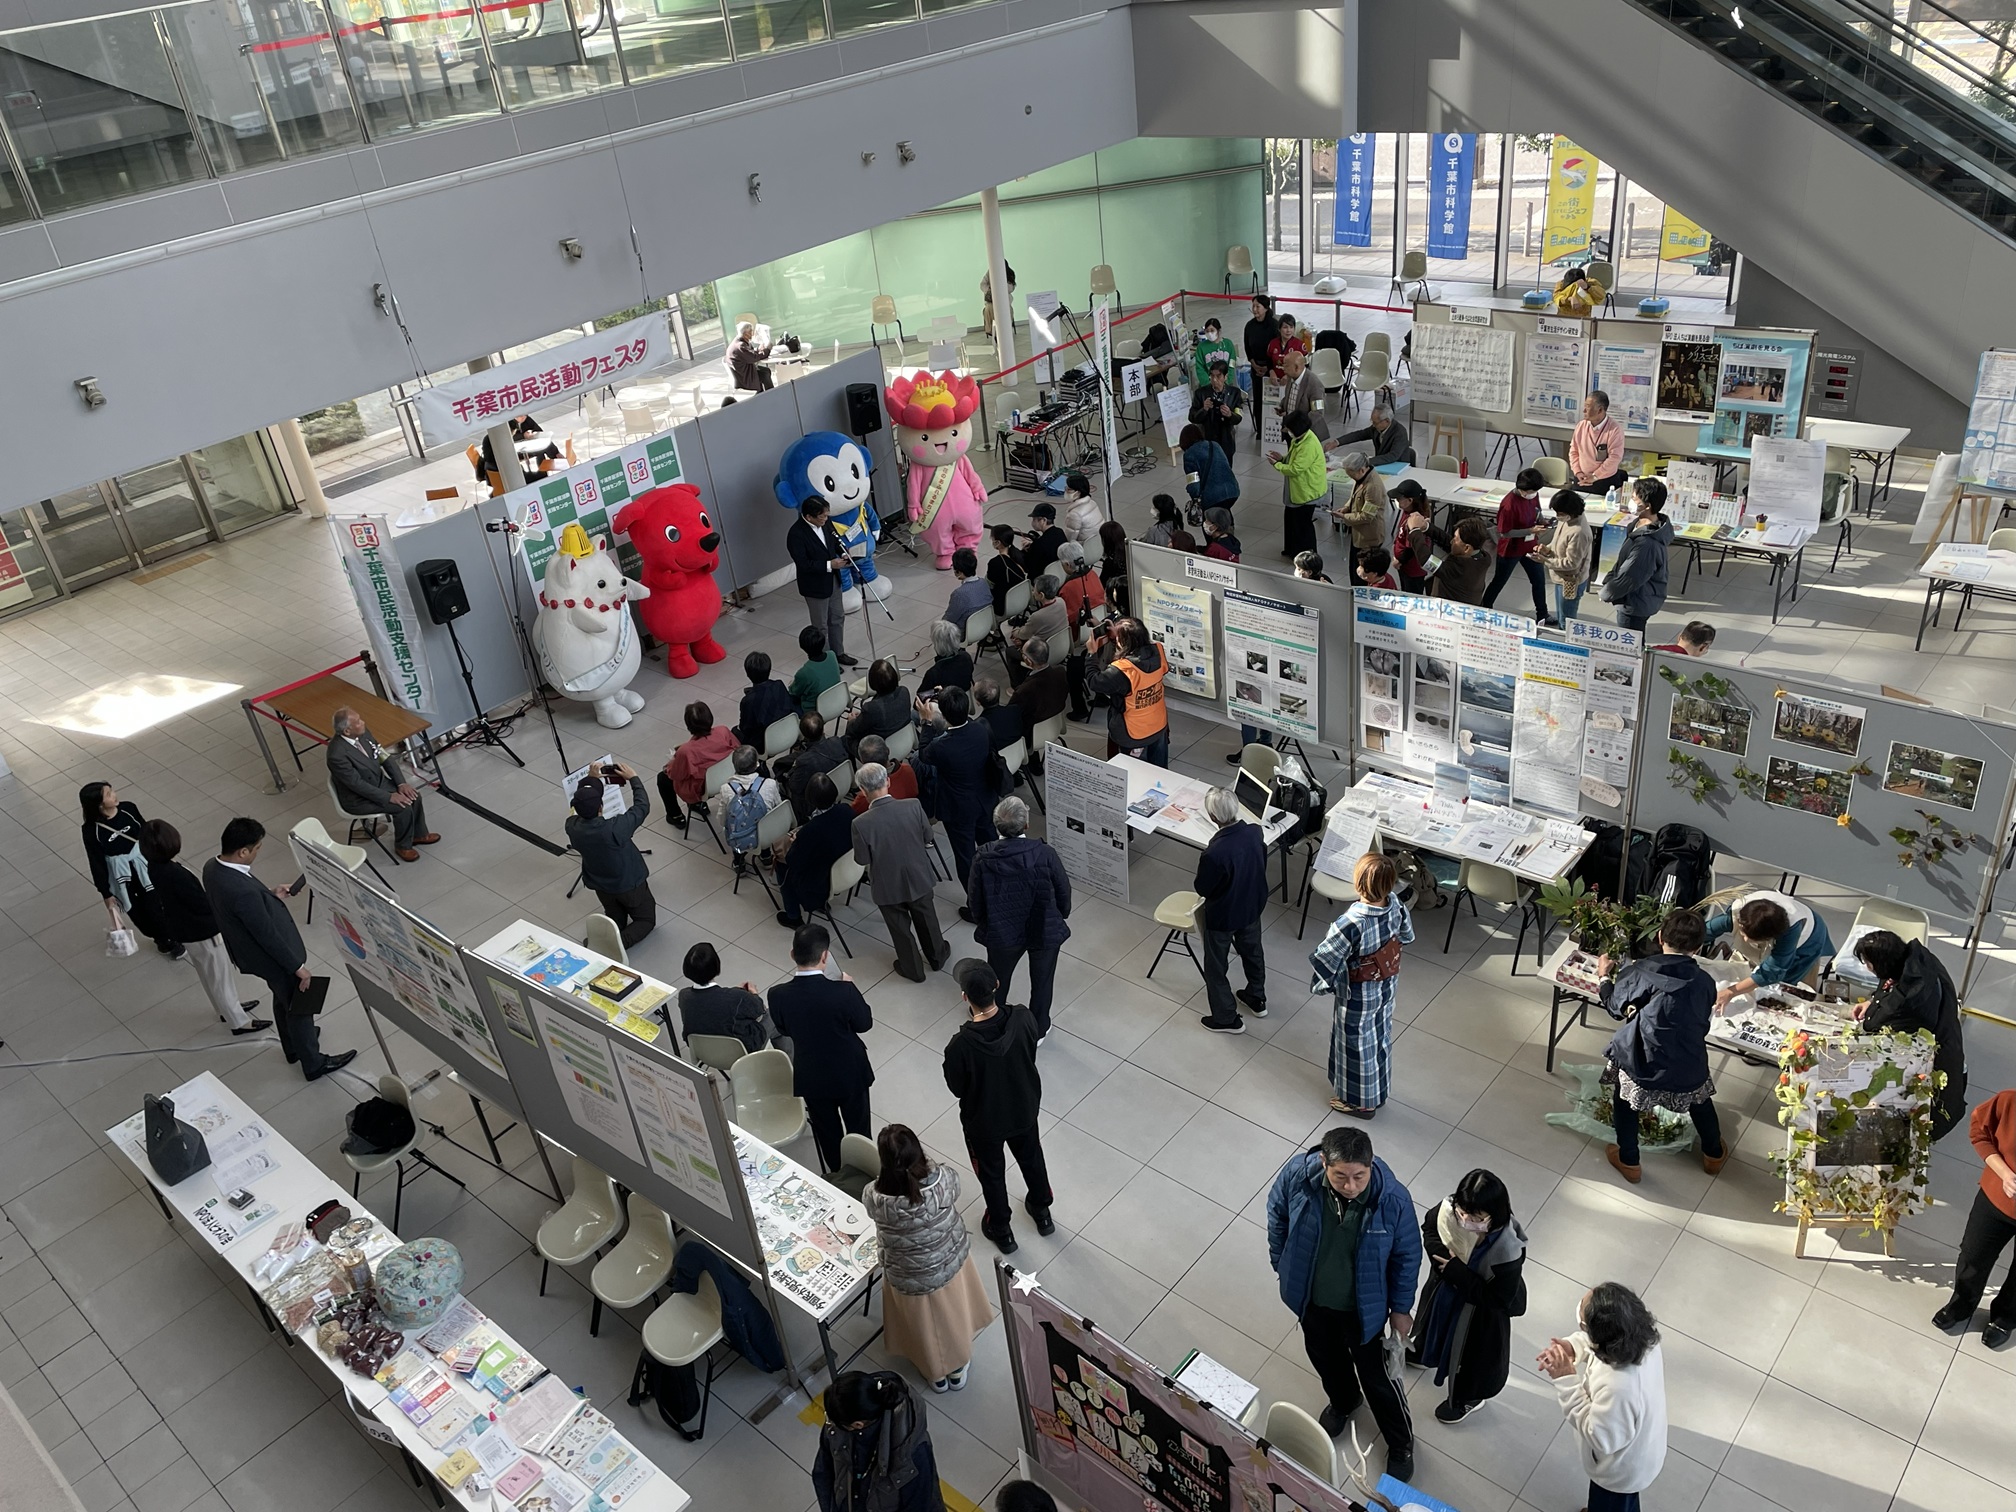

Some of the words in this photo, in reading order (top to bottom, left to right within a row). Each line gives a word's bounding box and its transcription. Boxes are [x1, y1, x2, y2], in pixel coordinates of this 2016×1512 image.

[1349, 148, 1362, 222] 千葉市科学館
[1443, 157, 1458, 235] 千葉市科学館
[1732, 342, 1783, 353] ちば演劇を見る会
[452, 338, 649, 425] 千葉市民活動フェスタ
[1128, 369, 1142, 398] 本部
[1156, 598, 1203, 616] NPOテクノサポート
[362, 547, 424, 710] 千葉市民活動支援センター
[1572, 622, 1636, 646] 蘇我の会
[1740, 1032, 1782, 1051] 園生の森公
[770, 1269, 826, 1311] 少国民が見た戦争
